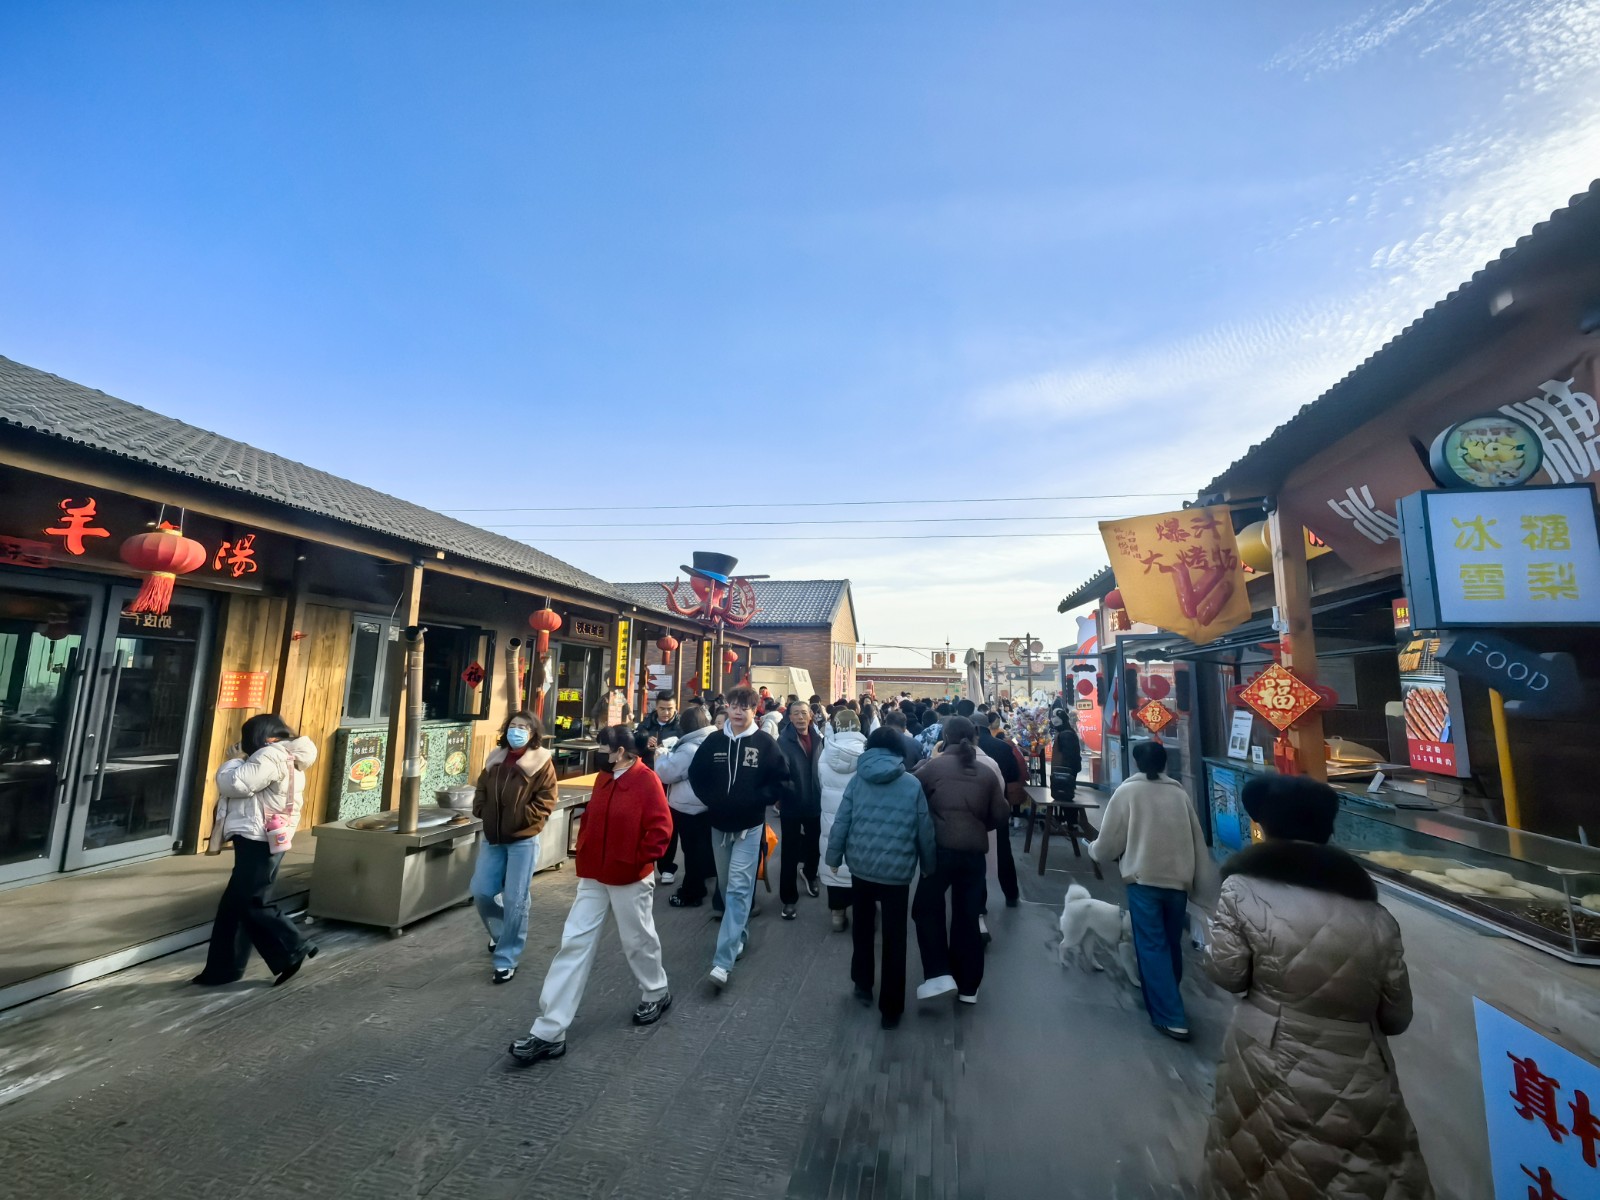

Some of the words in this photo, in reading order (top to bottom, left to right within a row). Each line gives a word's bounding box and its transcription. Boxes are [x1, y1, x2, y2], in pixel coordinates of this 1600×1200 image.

[1156, 517, 1222, 542] 爆汁
[1451, 514, 1571, 551] 冰糖
[1460, 562, 1579, 600] 雪梨
[1467, 641, 1549, 691] FOOD
[1259, 679, 1295, 710] 福
[1145, 707, 1161, 722] 福
